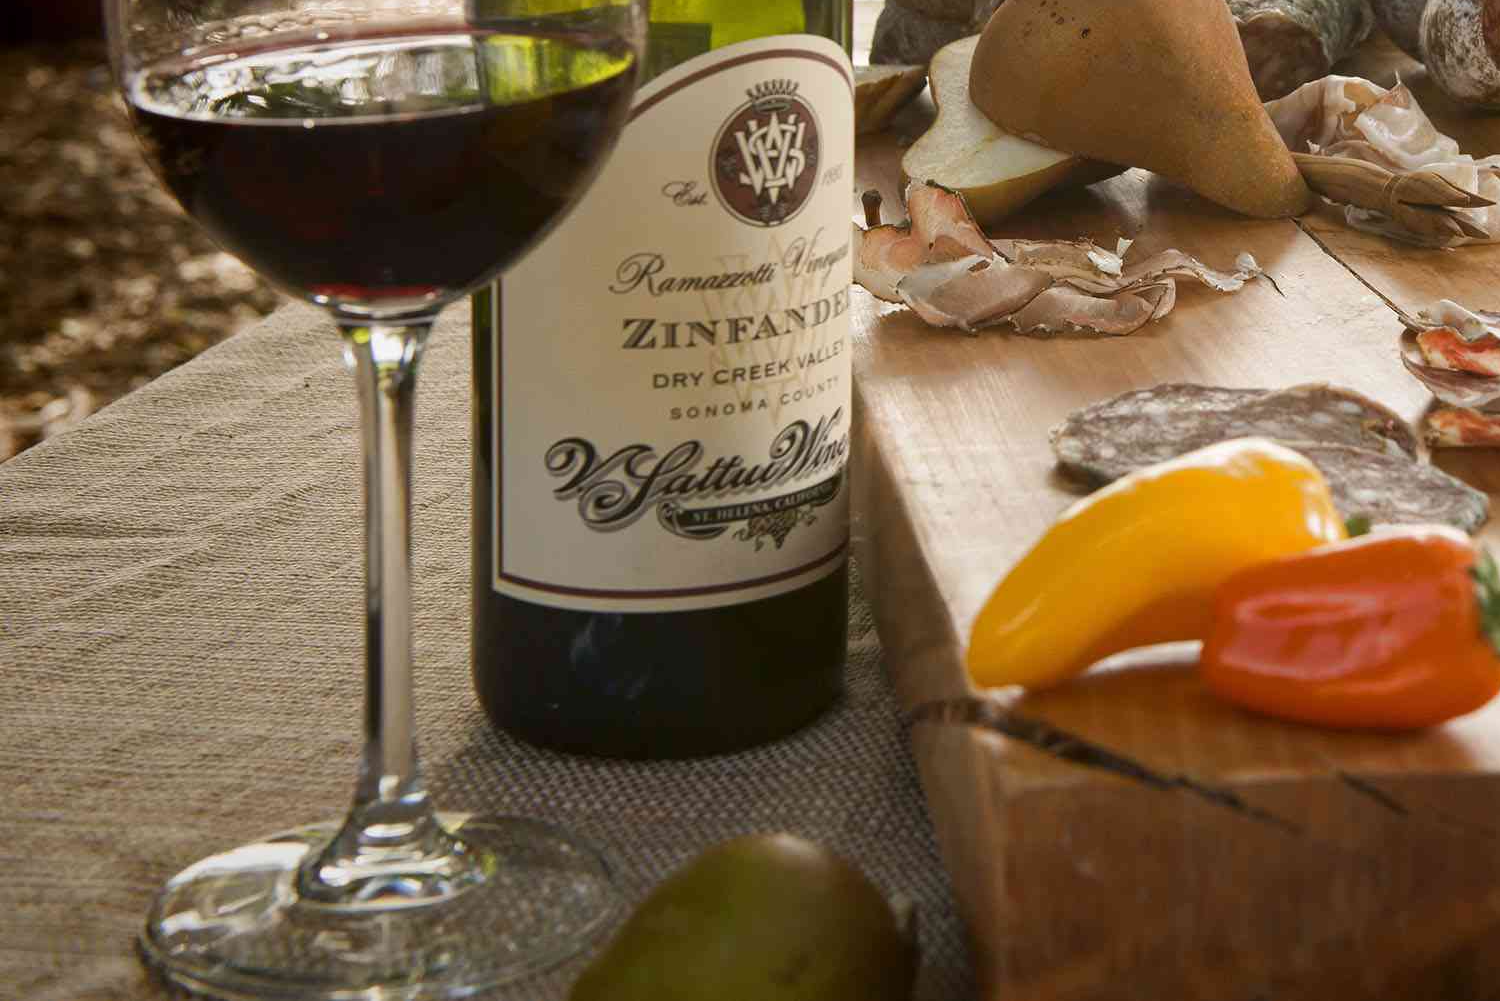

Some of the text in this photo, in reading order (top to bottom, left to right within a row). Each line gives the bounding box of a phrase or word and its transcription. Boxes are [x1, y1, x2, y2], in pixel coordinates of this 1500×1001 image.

[608, 252, 779, 298] Ramazzotti
[653, 372, 704, 389] DRY
[713, 358, 792, 386] CREEK
[669, 398, 769, 421] SONOMA
[767, 405, 849, 480] Wine
